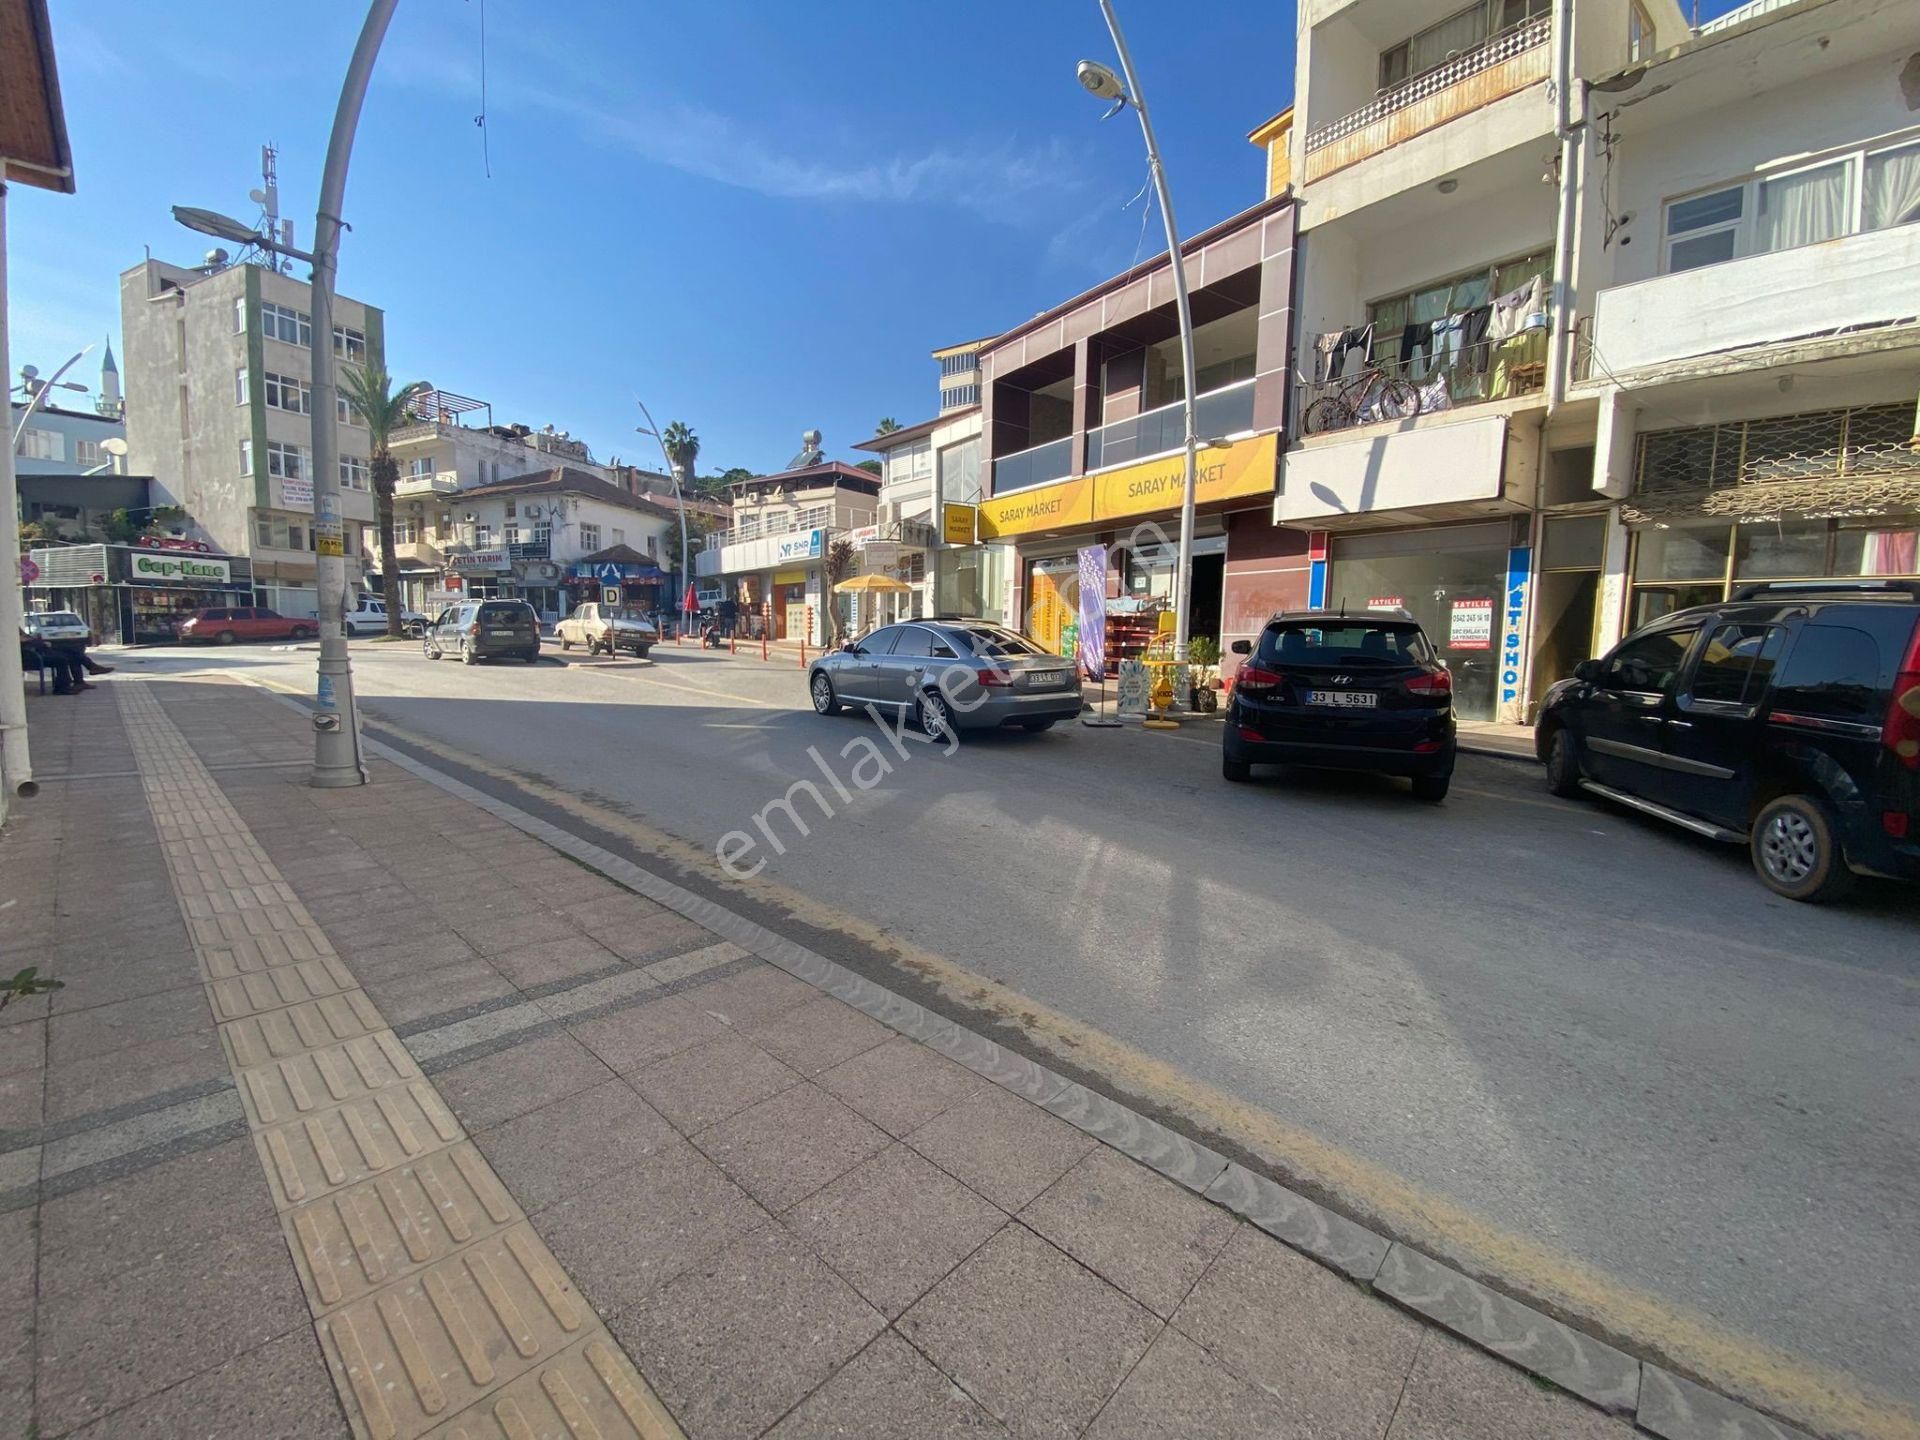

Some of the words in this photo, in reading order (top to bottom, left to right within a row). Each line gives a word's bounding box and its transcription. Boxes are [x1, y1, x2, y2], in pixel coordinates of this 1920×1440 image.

[1128, 475, 1168, 498] SARAY
[999, 507, 1027, 523] SARAY
[1026, 498, 1063, 517] MARKET
[607, 590, 617, 602] D
[1502, 633, 1520, 703] SHOP
[1312, 692, 1326, 702] 33
[1332, 693, 1339, 703] L
[1345, 693, 1375, 705] 5631
